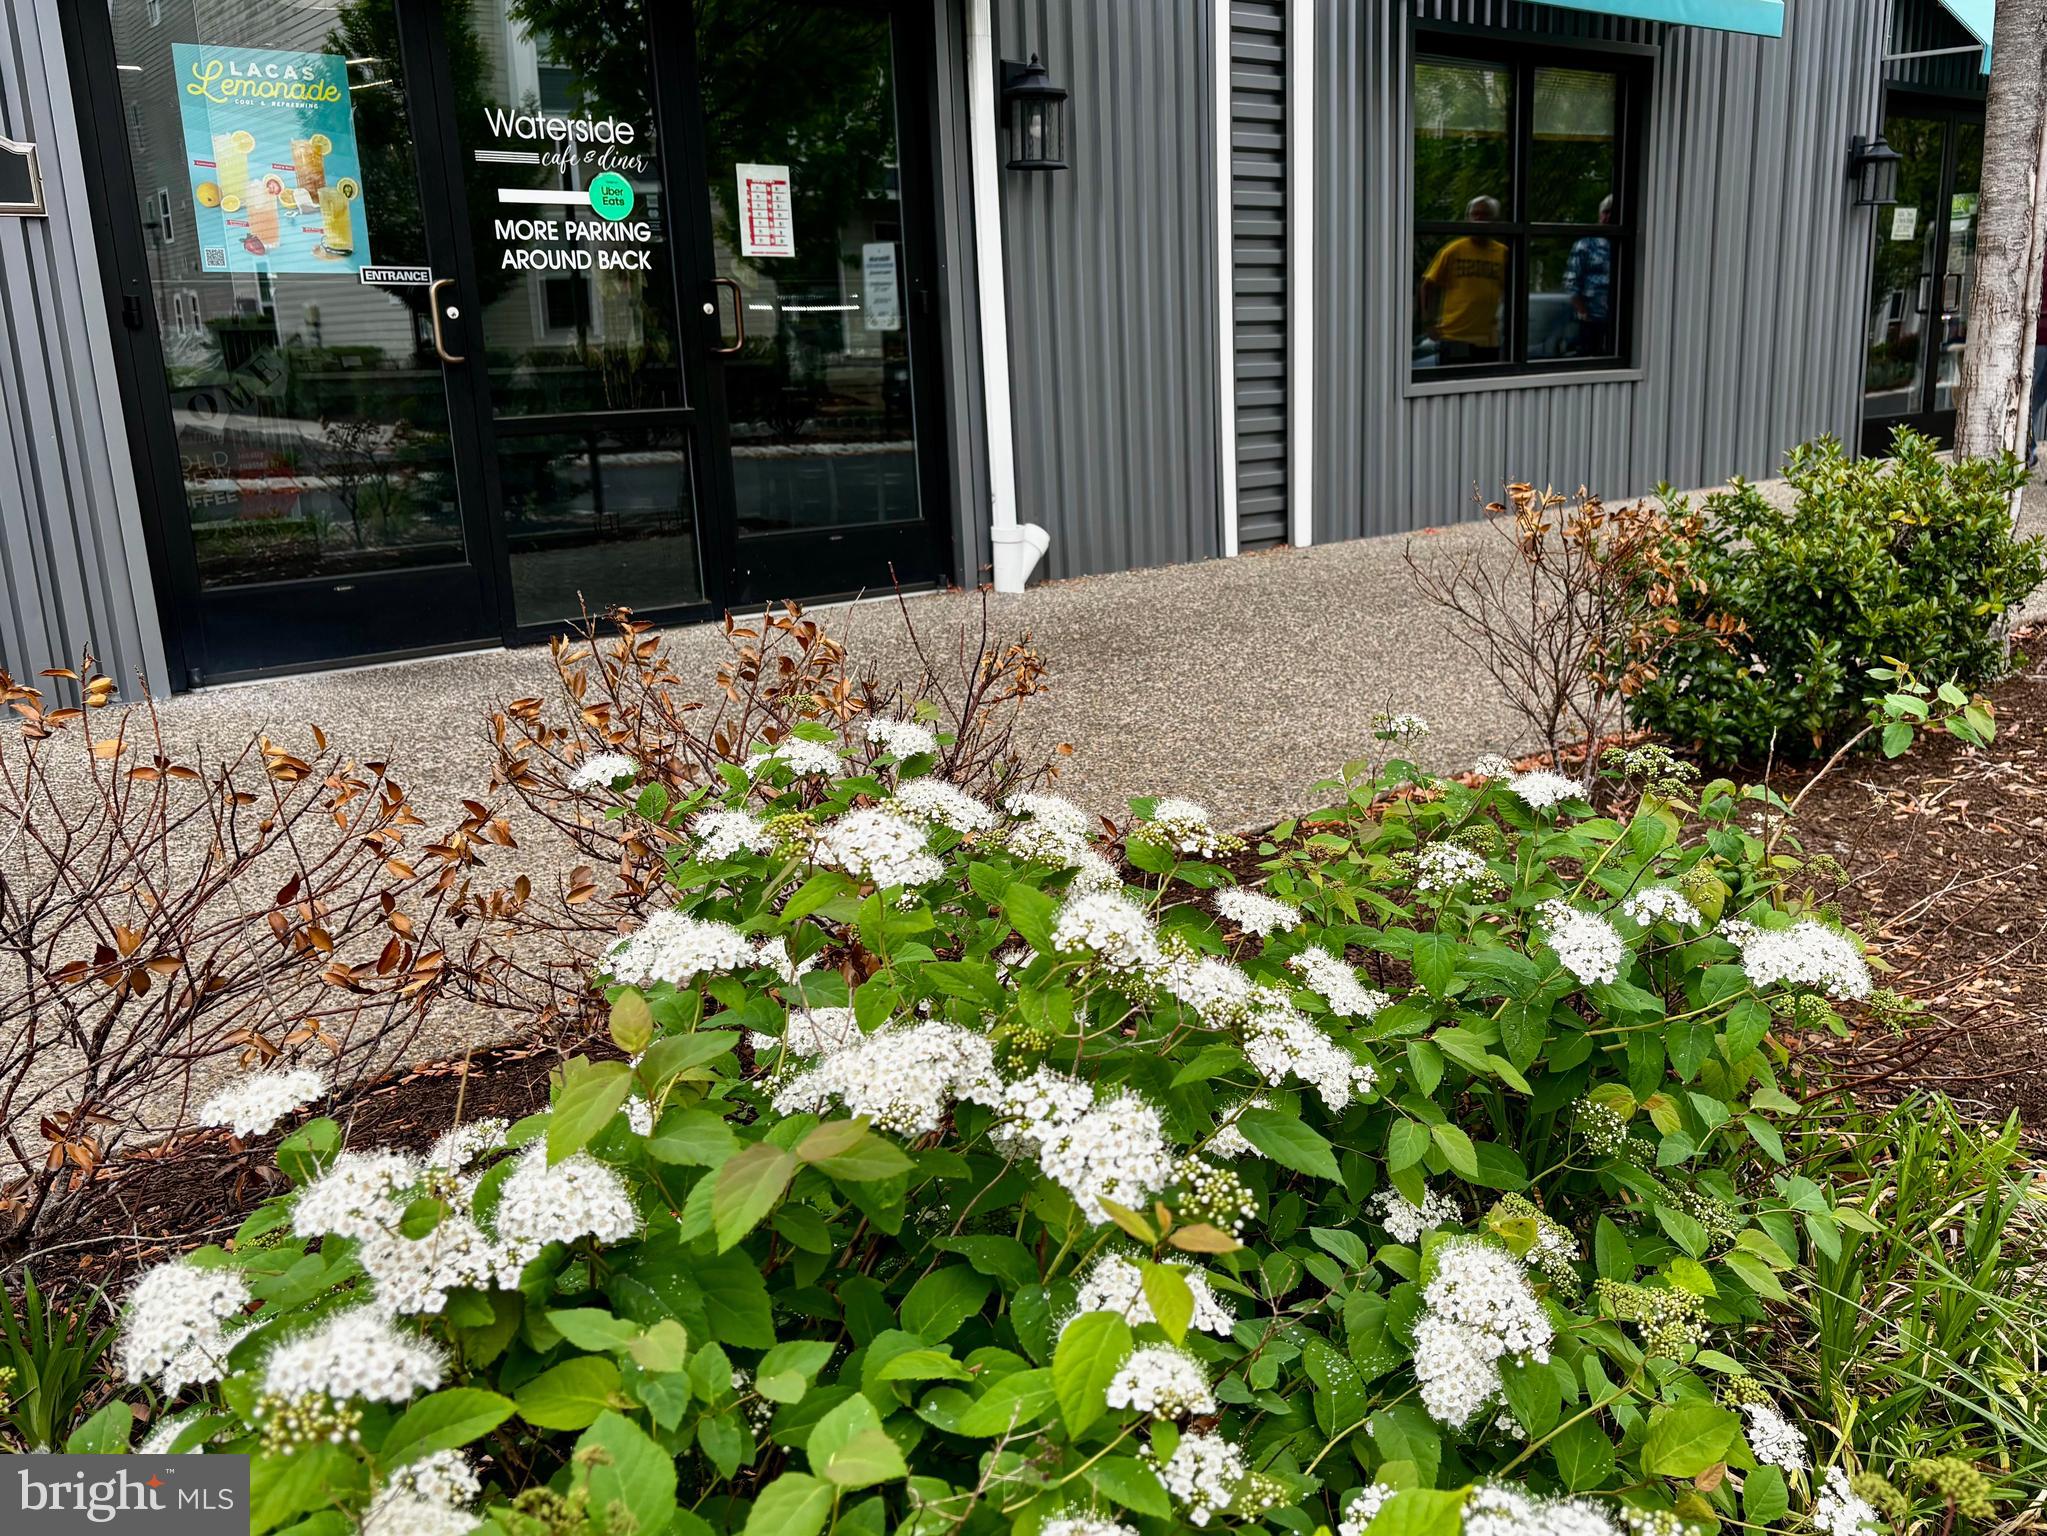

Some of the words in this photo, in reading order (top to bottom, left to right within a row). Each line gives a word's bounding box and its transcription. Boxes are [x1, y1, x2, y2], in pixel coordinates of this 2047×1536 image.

[229, 61, 315, 81] LACAS
[187, 59, 341, 104] Lemonade
[235, 98, 254, 106] COOL
[271, 101, 319, 110] REFRESHING
[484, 107, 635, 145] Waterside
[541, 144, 582, 175] cafe
[583, 150, 597, 164] &
[597, 144, 649, 174] diner
[601, 186, 624, 196] Uber
[602, 196, 625, 206] Eats
[494, 219, 560, 241] MORE
[565, 220, 652, 243] PARKING
[501, 249, 593, 270] AROUND
[598, 249, 653, 270] BACK
[364, 270, 429, 282] ENTRANCE
